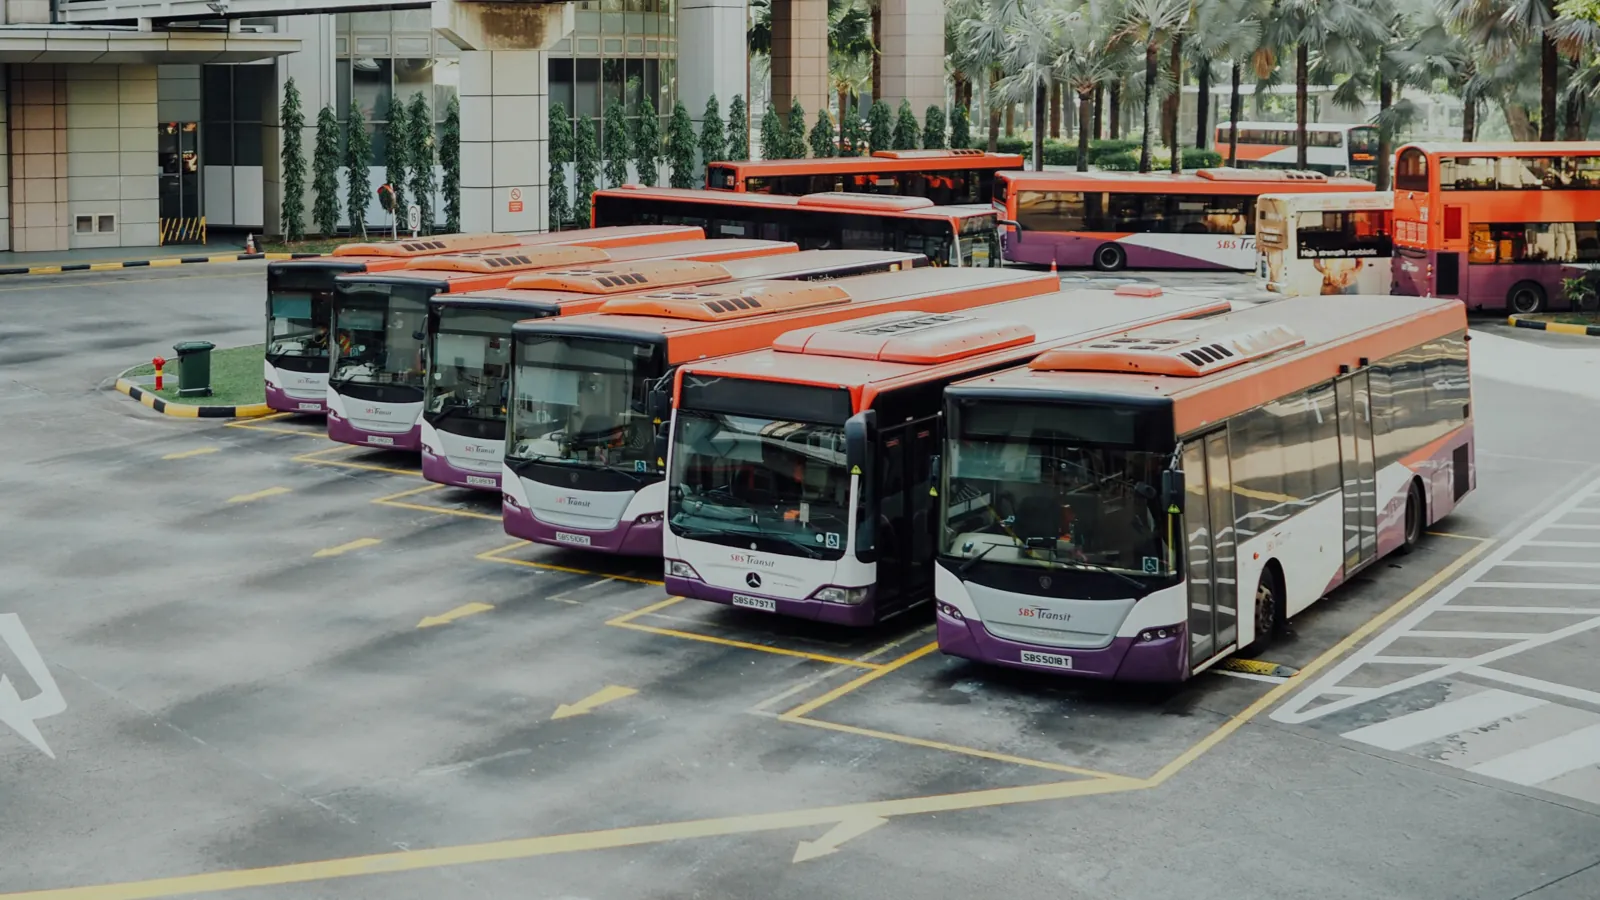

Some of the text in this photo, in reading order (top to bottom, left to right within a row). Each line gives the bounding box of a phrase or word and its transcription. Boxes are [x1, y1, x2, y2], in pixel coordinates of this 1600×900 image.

[1216, 240, 1236, 249] SBS
[1319, 248, 1346, 257] strength
[1347, 248, 1377, 256] probiotic
[730, 554, 775, 568] SBS Transit
[733, 595, 775, 609] SBS6797X
[1018, 606, 1072, 622] SBS Transit
[1023, 653, 1070, 666] SBS5018T
